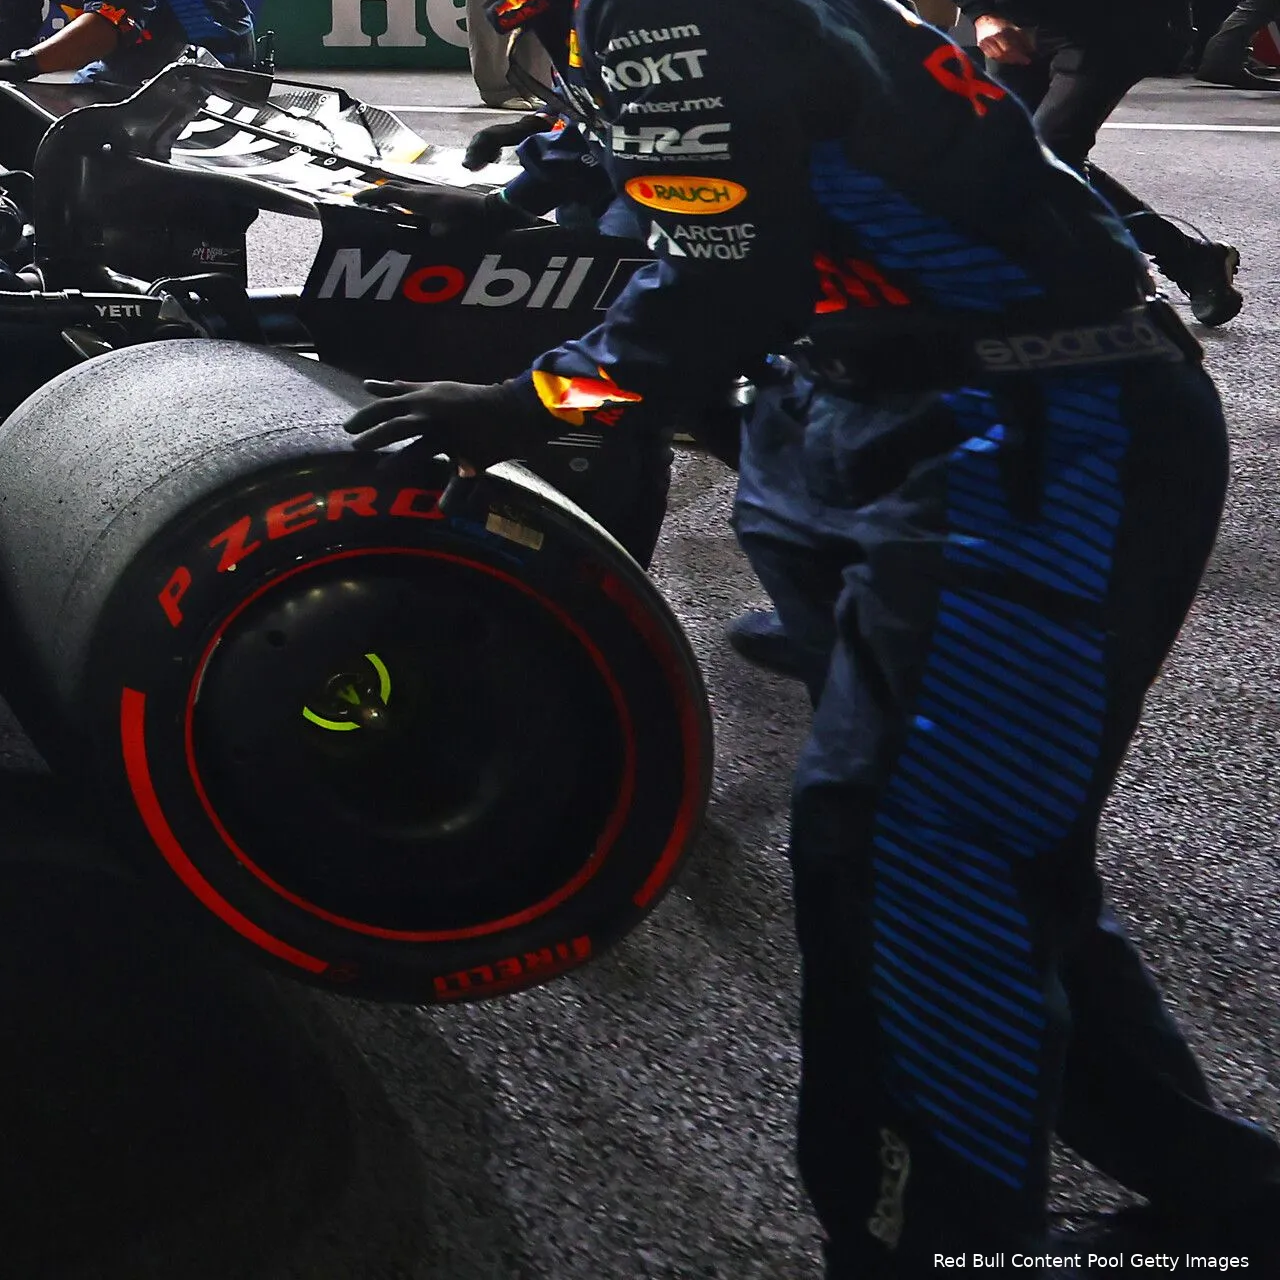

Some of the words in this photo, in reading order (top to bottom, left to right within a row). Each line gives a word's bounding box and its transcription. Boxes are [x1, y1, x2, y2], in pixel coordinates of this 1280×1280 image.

[600, 48, 708, 92] ROKT
[612, 122, 731, 154] HRC
[654, 183, 731, 204] RAUCH
[673, 223, 756, 240] ARCTIC
[686, 241, 751, 261] WOLF
[317, 248, 594, 309] Mobil
[94, 304, 142, 318] YETI
[976, 324, 1159, 368] sparco
[158, 566, 192, 627] P
